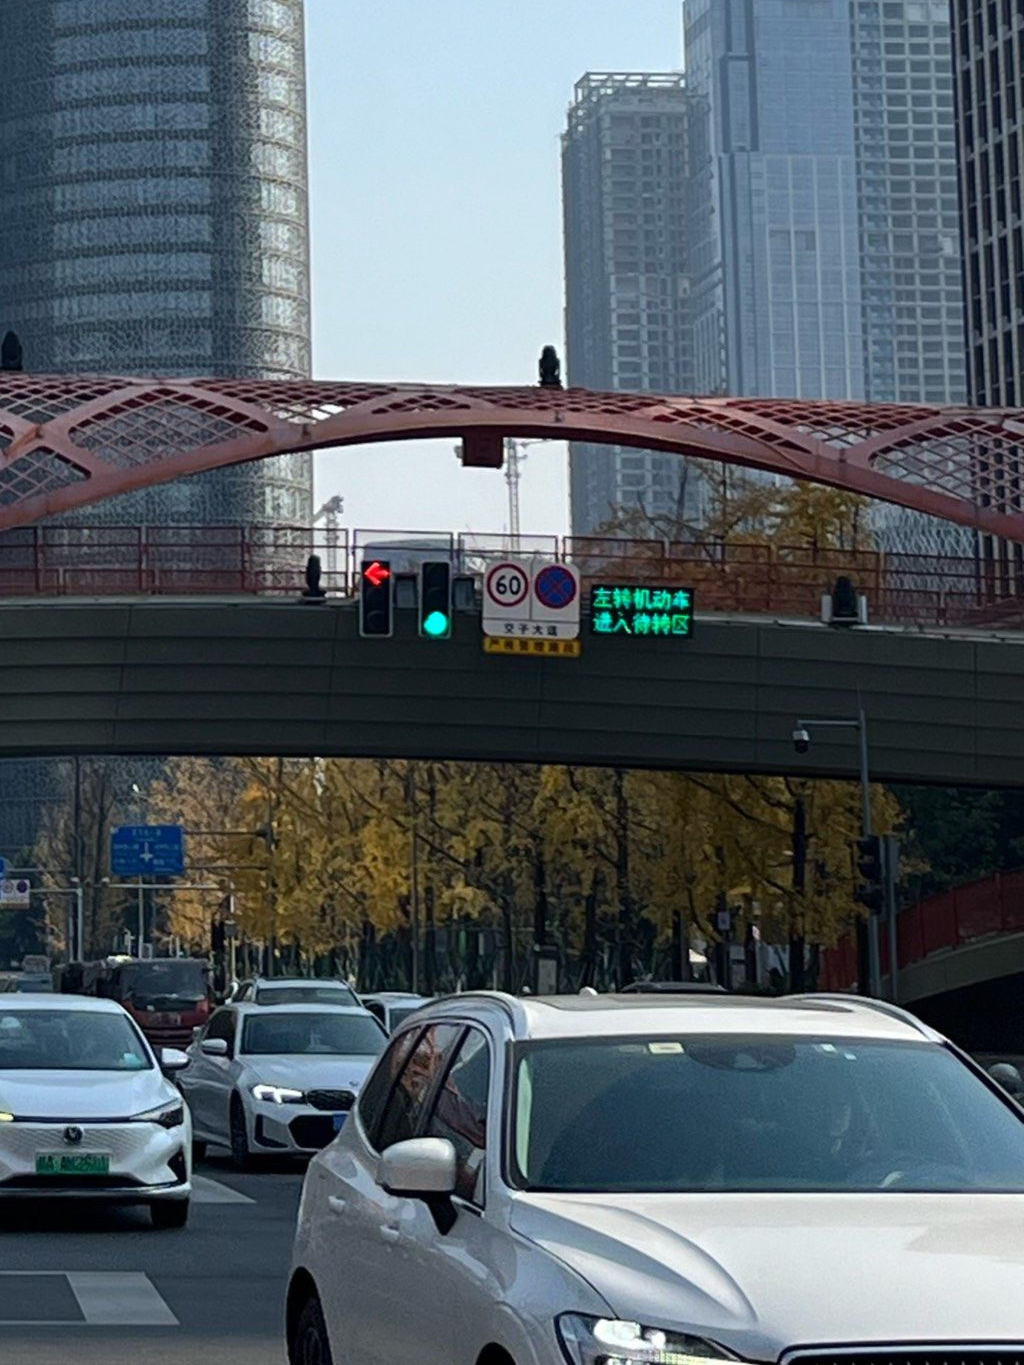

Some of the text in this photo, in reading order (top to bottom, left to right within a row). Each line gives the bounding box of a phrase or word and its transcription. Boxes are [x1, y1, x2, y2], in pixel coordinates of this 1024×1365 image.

[496, 575, 521, 595] 60
[593, 588, 690, 610] 左转机动车
[504, 623, 558, 636] 交子大道
[593, 612, 689, 635] 进入待转区
